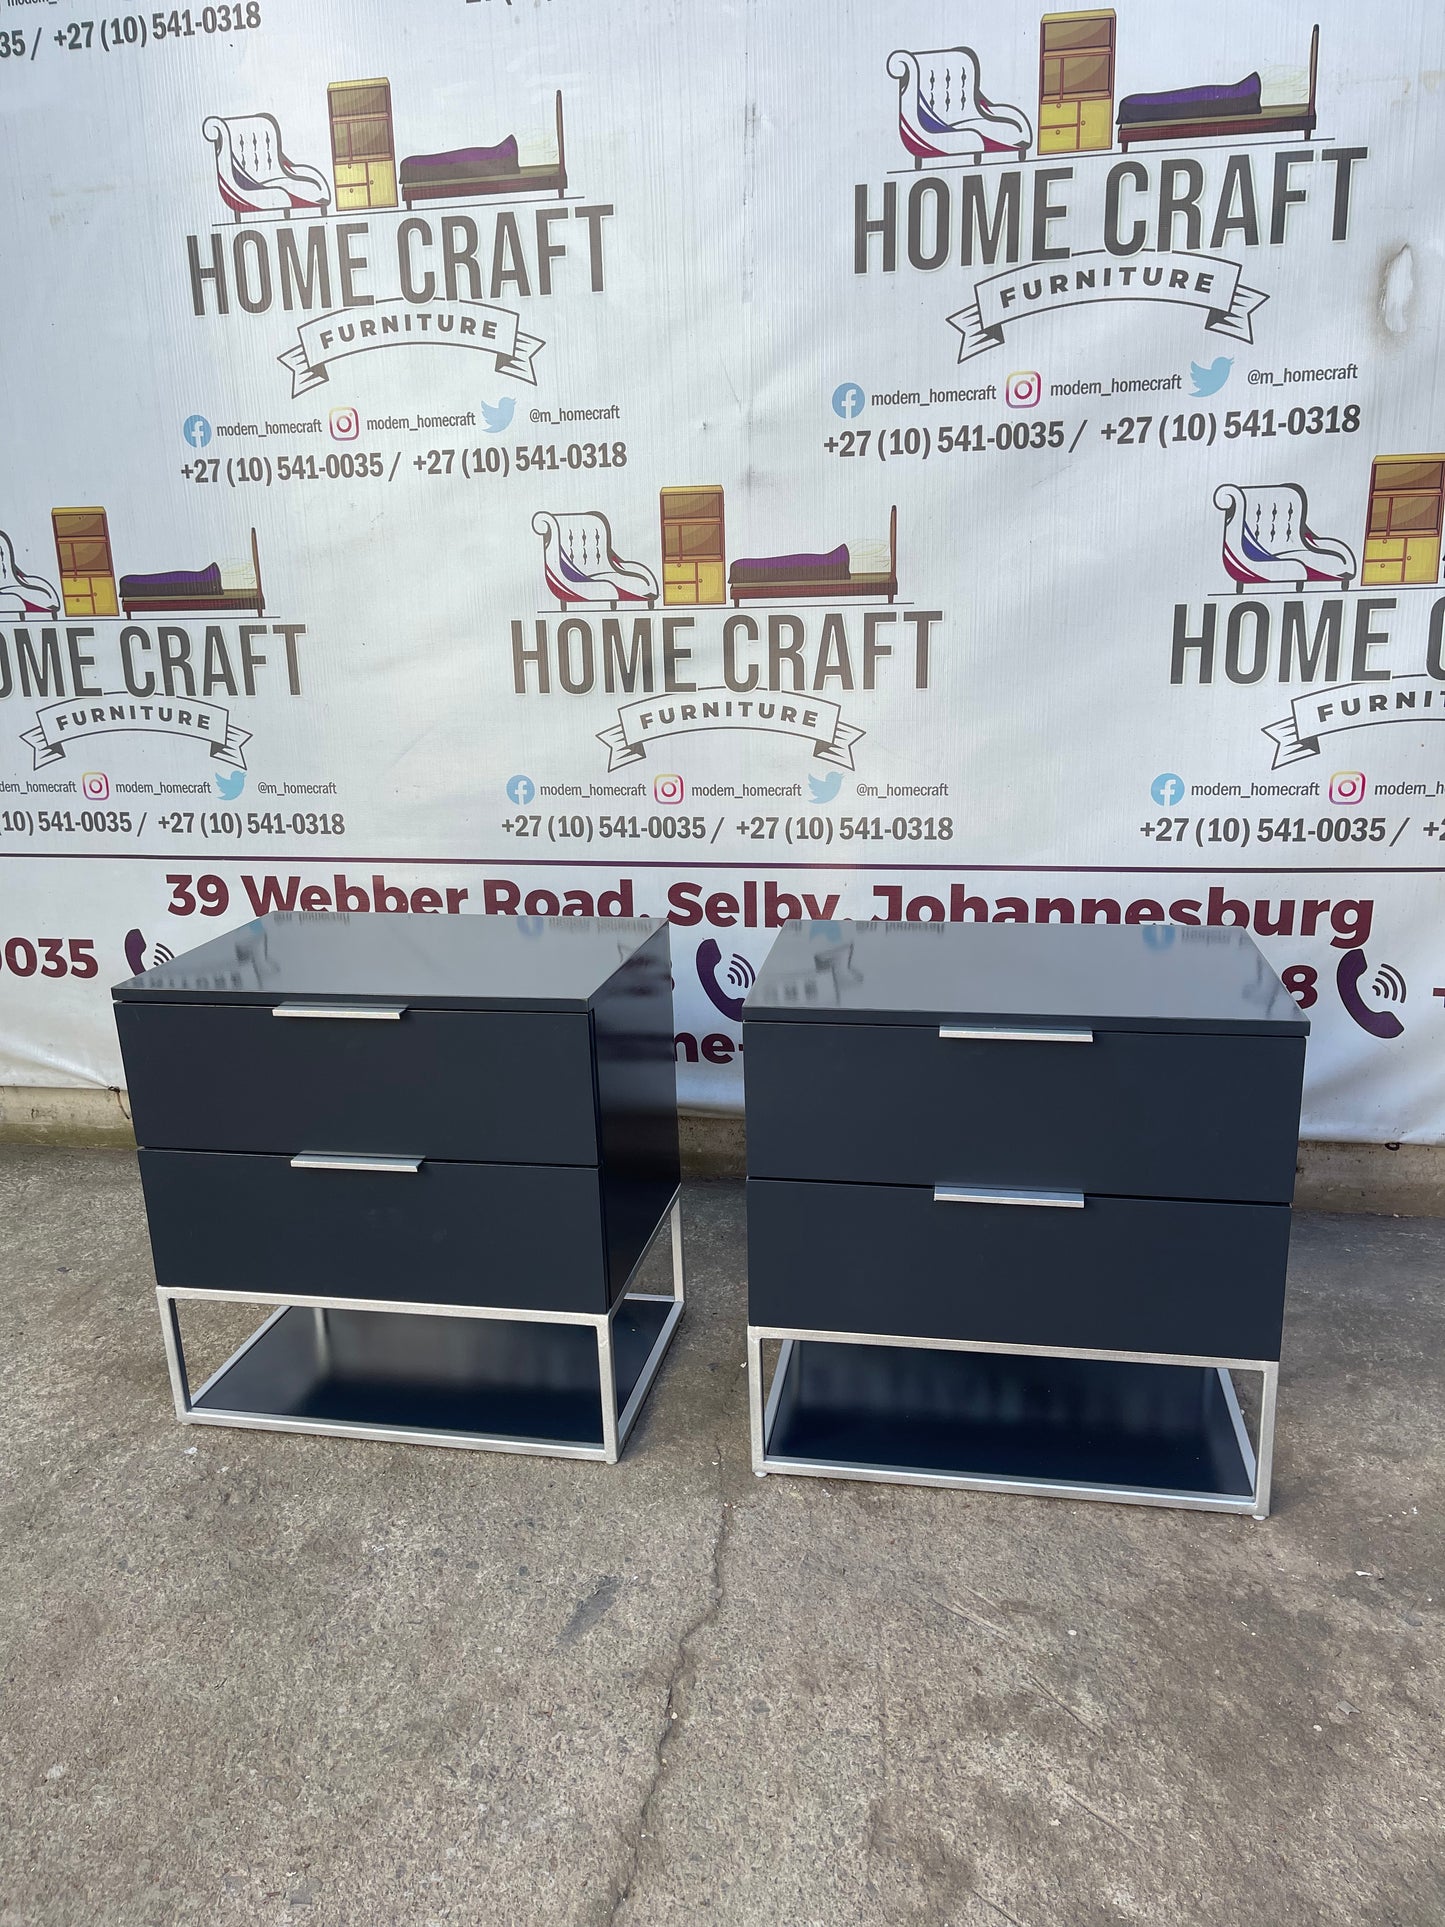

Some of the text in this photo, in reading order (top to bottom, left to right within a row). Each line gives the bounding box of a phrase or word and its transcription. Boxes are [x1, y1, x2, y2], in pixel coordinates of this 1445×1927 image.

[31, 27, 42, 60] /
[54, 21, 94, 50] +27
[101, 15, 147, 52] (10)
[152, 2, 261, 40] 541-0318
[854, 147, 1368, 274] HOME CRAFT
[186, 204, 613, 316] HOME CRAFT
[1000, 266, 1214, 308] FURNITURE
[319, 313, 498, 349] FURNITURE
[871, 363, 1358, 406] modern_homecraft modern_homecraft @m_homecraft
[216, 405, 620, 437] modern_homecraft modern_homecraft @m_homecraft
[824, 404, 1361, 461] +27 (10) 541-0035 / +27 (10) 541-0318
[181, 442, 627, 487] +27 (10) 541-0035 / +27 (10) 541-0318
[120, 624, 306, 697] CRAFT
[511, 610, 943, 694] HOME CRAFT
[1170, 598, 1397, 684] HOME
[56, 705, 210, 730] FURNITURE
[640, 701, 819, 730] FURNITURE
[1317, 690, 1445, 722] FURNI
[116, 781, 211, 796] modern_homecraft
[258, 782, 337, 796] @m_homecraft
[540, 783, 949, 799] modern_homecraft modern_homecraft @m_homecraft
[1191, 783, 1320, 798] modern_homecraft
[0, 811, 345, 838] 10) 541-0035 / +27 (10) 541-0318
[502, 815, 954, 844] +27 (10) 541-0035 / +27 (10) 541-0318
[1140, 817, 1190, 842] +27
[1195, 818, 1250, 847] (10)
[1257, 817, 1386, 842] 541-0035
[1389, 817, 1410, 847] /
[166, 874, 229, 917] 39
[240, 874, 469, 917] Webber
[667, 881, 853, 928] Selby
[871, 883, 1373, 948] Johannesburg
[0, 937, 99, 978] 035
